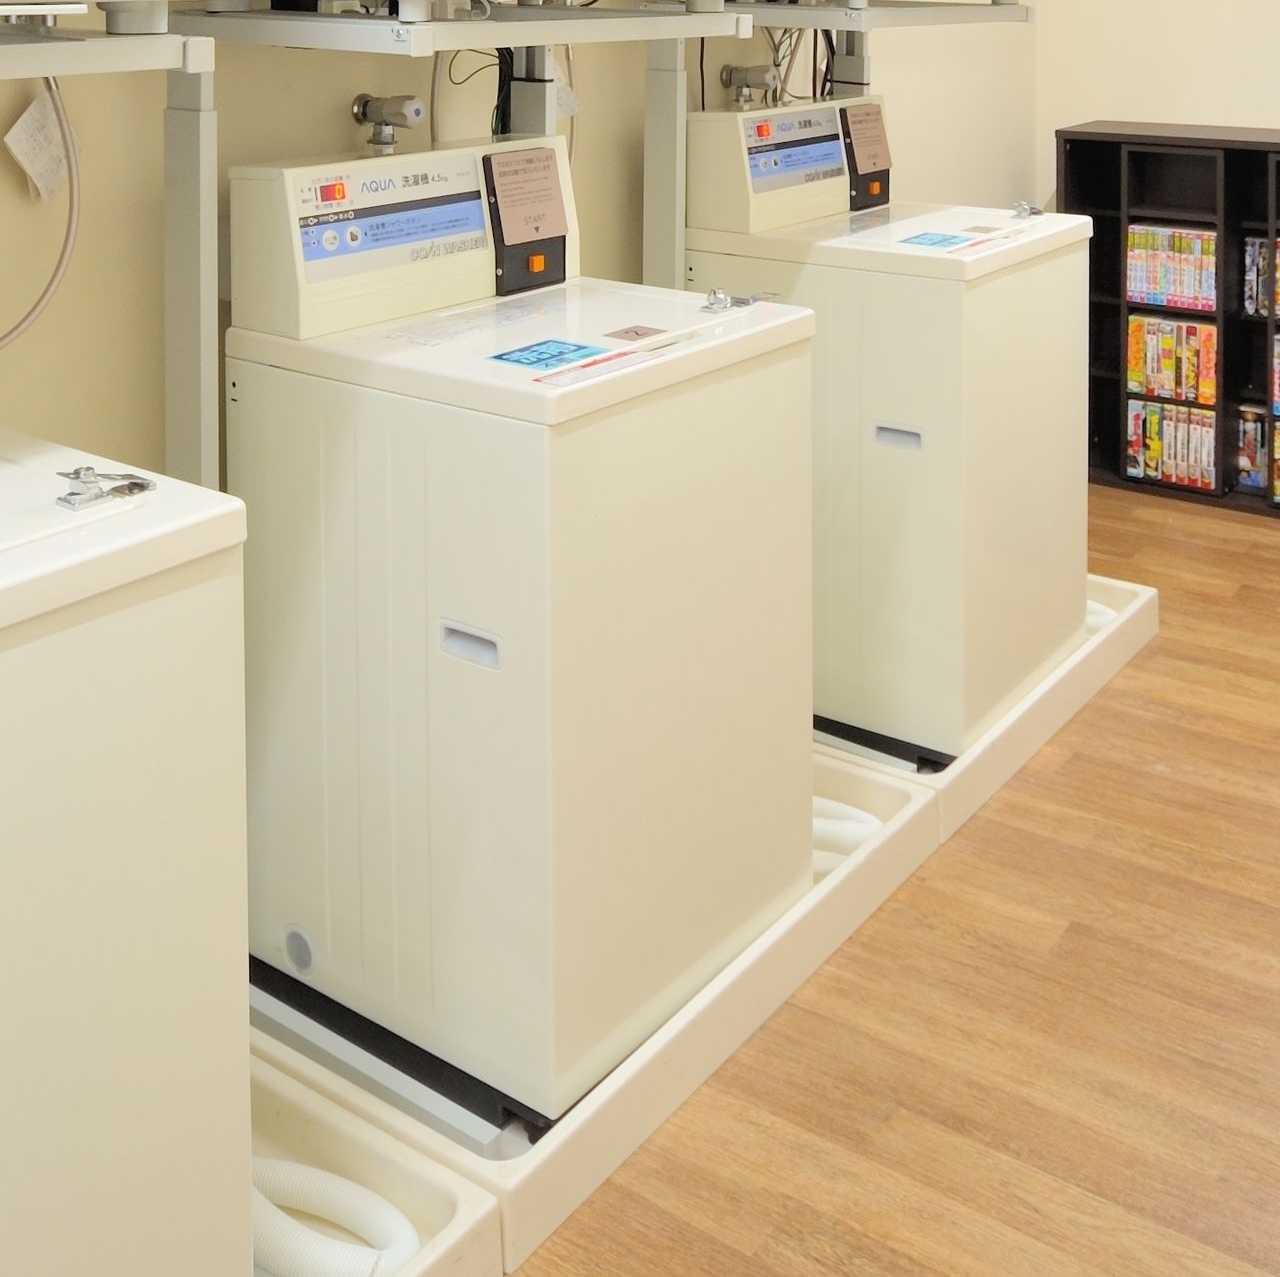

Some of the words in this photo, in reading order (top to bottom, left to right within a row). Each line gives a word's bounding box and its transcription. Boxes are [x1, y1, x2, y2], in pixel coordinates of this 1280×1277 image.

[361, 178, 397, 194] AQUA
[524, 213, 547, 225] START
[409, 242, 441, 261] COIN
